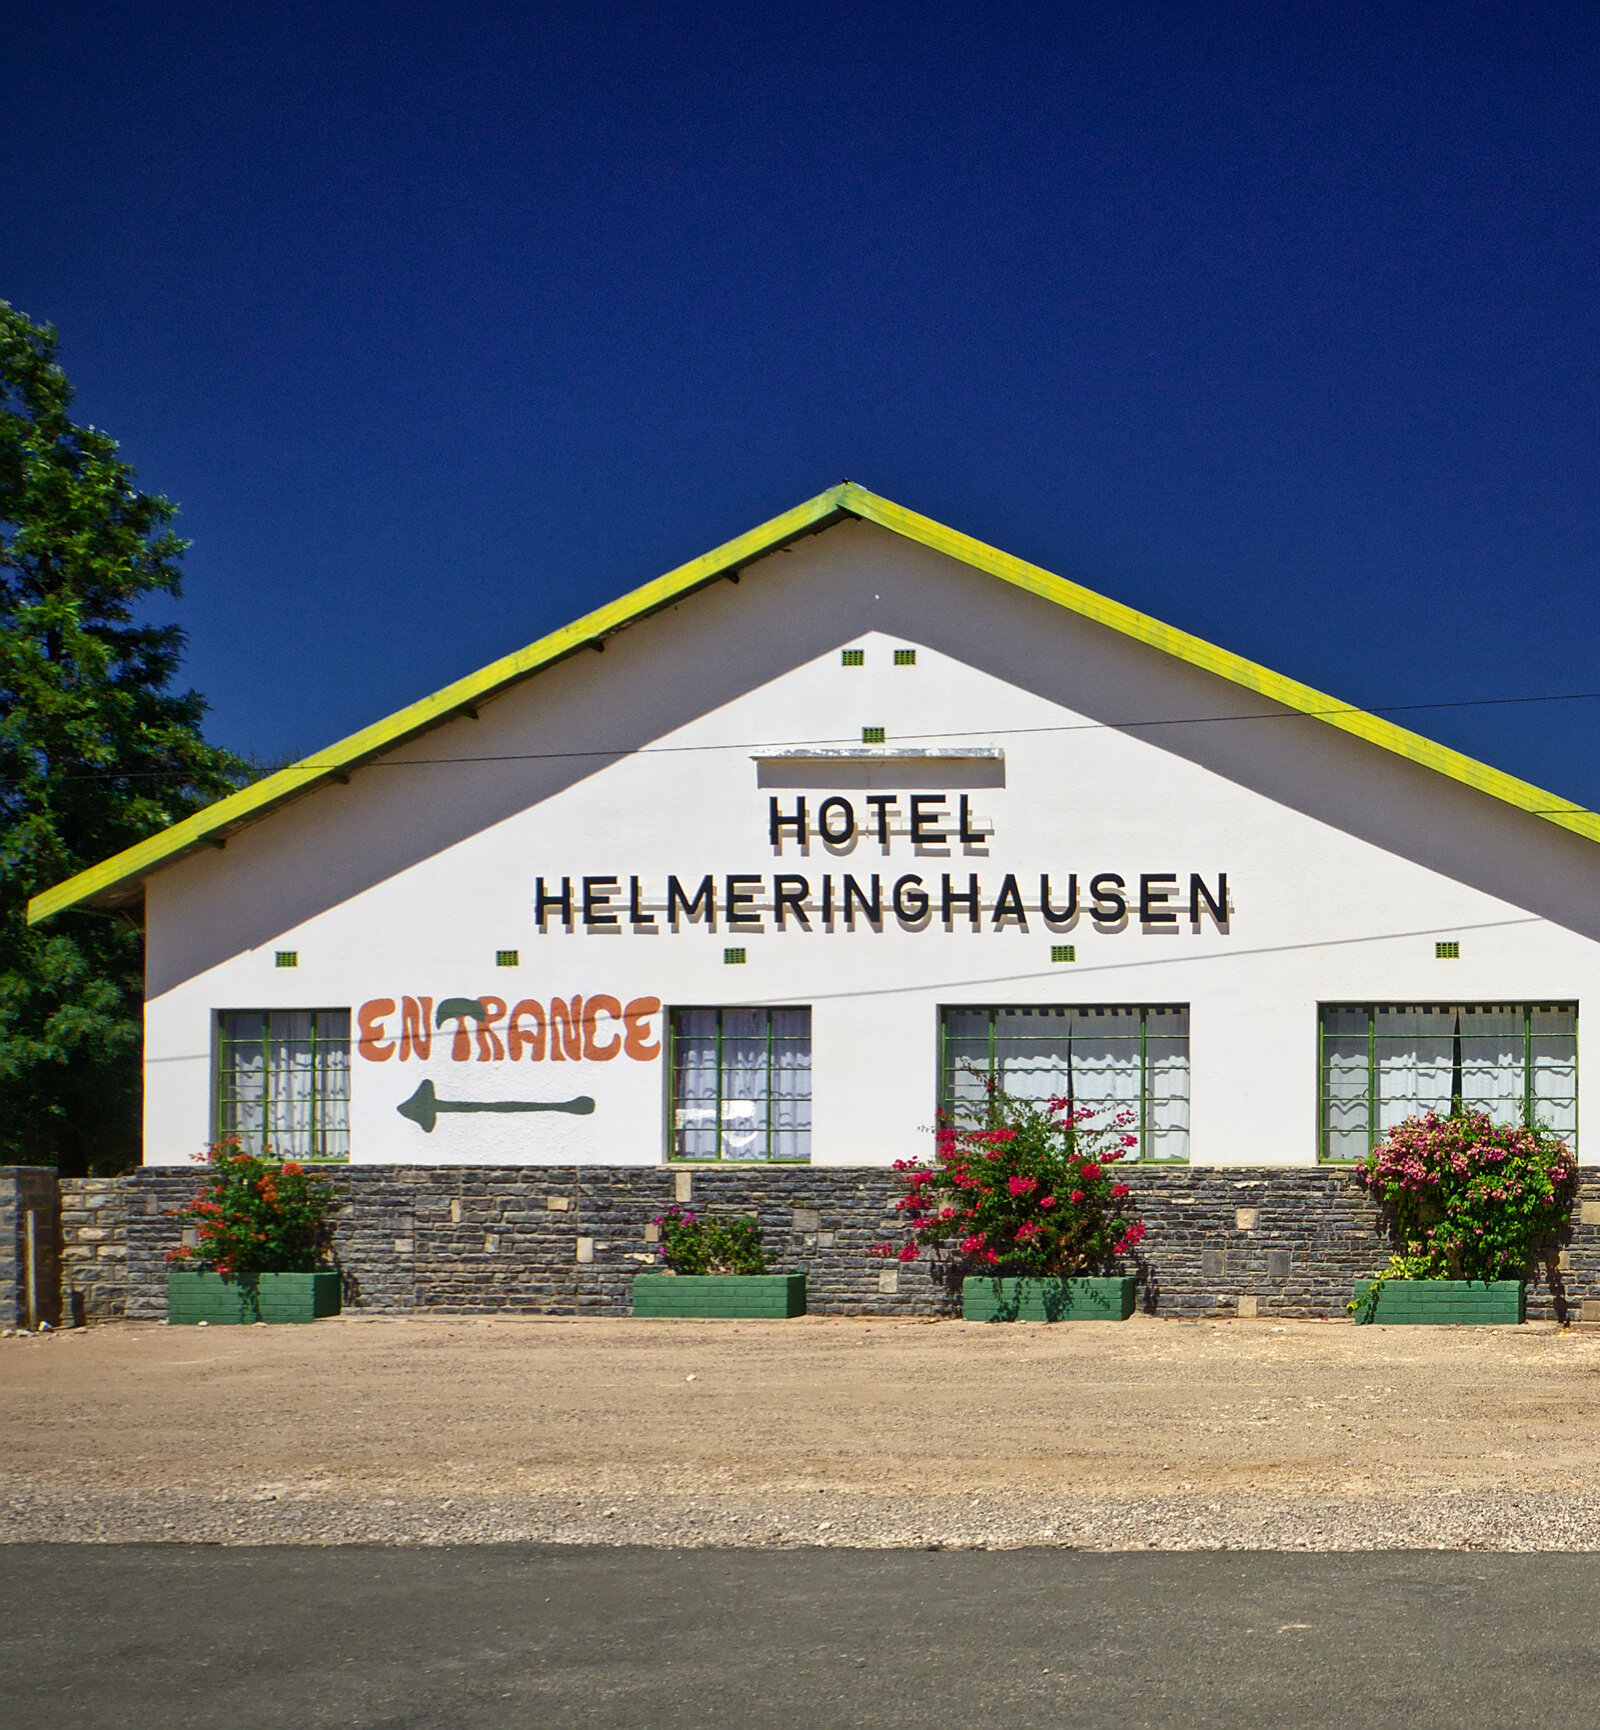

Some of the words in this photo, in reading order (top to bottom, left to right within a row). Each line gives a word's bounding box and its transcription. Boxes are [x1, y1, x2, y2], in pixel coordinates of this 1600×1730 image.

[769, 794, 986, 845] HOTEL
[535, 872, 1229, 926] HELMERINGHAUSEN
[358, 994, 661, 1062] ENTRANCE
